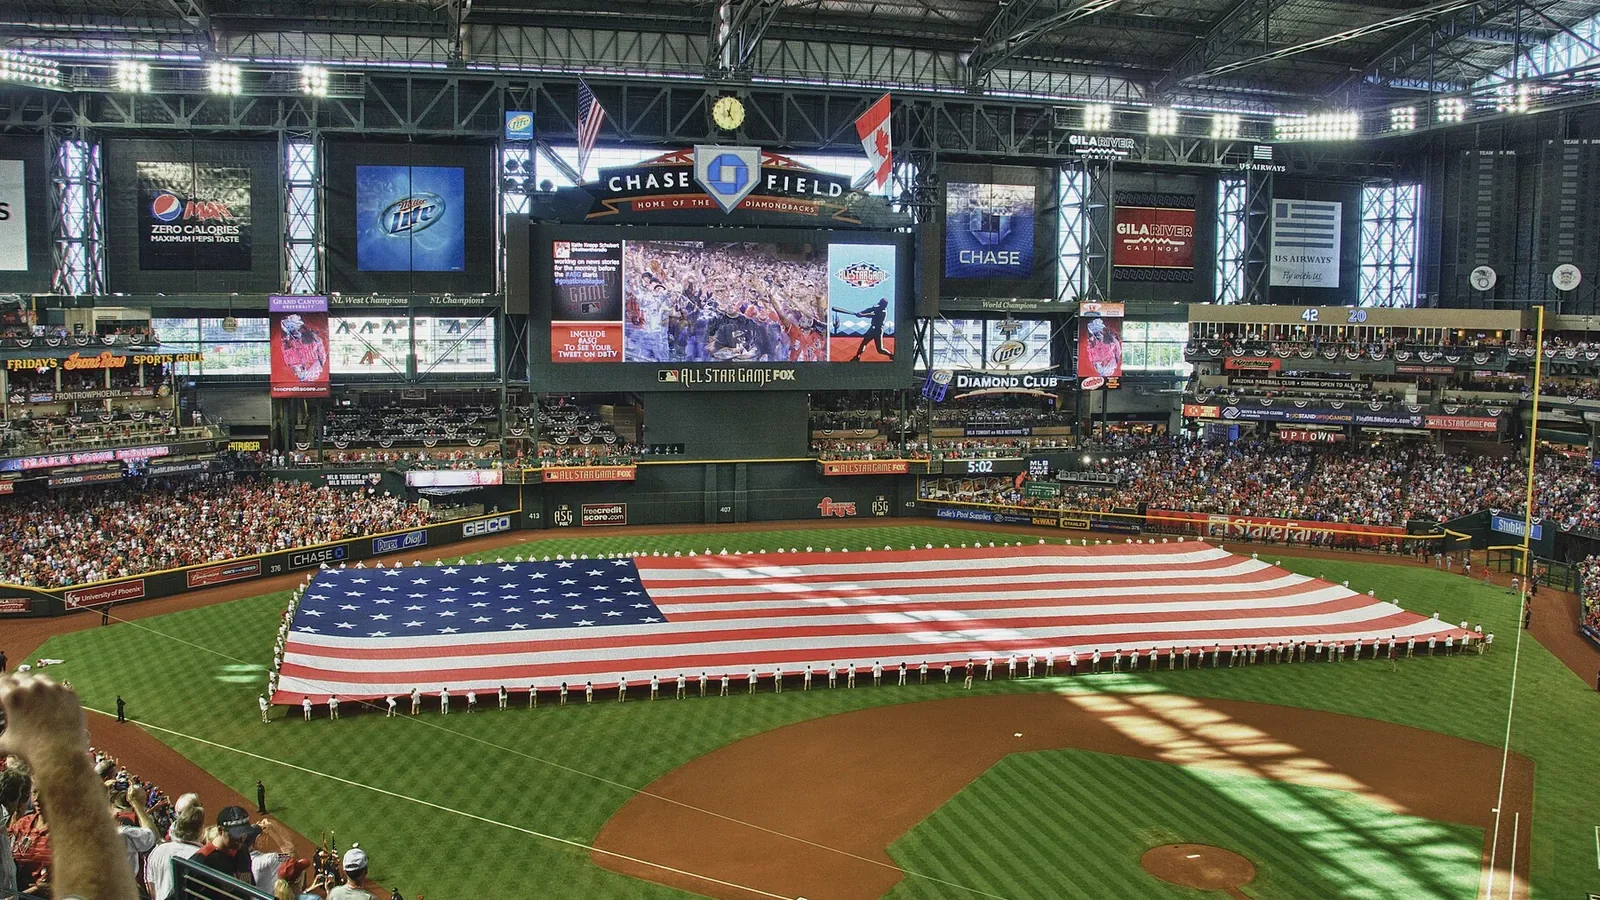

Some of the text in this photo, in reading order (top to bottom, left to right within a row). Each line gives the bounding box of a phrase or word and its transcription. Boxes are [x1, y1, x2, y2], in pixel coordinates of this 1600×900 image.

[1069, 135, 1135, 149] GILA RIVER
[1252, 164, 1286, 172] AIRWAYS
[608, 172, 842, 198] CHASE FIELD
[745, 201, 815, 213] DIAMONDBACKS
[389, 204, 435, 234] Lite
[151, 225, 239, 234] ZERO CALORIES
[1116, 223, 1193, 237] GILA RIVER
[960, 251, 1020, 265] CHASE
[1283, 271, 1311, 283] Fly with
[569, 285, 610, 302] GAME
[366, 297, 408, 305] Champions
[443, 297, 485, 305] Champions
[1003, 302, 1037, 310] Champions
[1302, 308, 1367, 322] 42 20
[998, 346, 1022, 361] Lite
[7, 358, 57, 370] FRIDAY'S
[101, 351, 127, 369] Row
[133, 354, 173, 365] SPORTS
[176, 352, 204, 363] GRILL
[681, 368, 795, 387] ALL STAR GAME FOX
[957, 375, 1058, 388] DIAMOND CLUB
[54, 389, 131, 400] FRONTROWPHOENIX.com
[1447, 418, 1465, 426] STAR
[1465, 419, 1483, 428] GAME
[1281, 430, 1335, 441] UPTOWN
[840, 464, 853, 473] ALL
[854, 464, 872, 472] STAR
[873, 464, 891, 472] GAME
[967, 461, 993, 473] 5:02
[560, 470, 574, 479] ALL
[575, 470, 594, 479] STAR
[595, 469, 616, 479] GAME
[0, 483, 13, 491] FOX
[583, 506, 622, 514] freecredit
[872, 501, 888, 515] ASG
[554, 510, 572, 524] ASG
[937, 509, 991, 522] Leslie's Pool Supplies
[464, 517, 509, 535] GEICO
[1498, 519, 1534, 537] StubHu!
[378, 531, 422, 551] Purex Dial
[293, 551, 333, 566] CHASE
[270, 564, 281, 573] 376
[81, 591, 111, 602] University
[118, 585, 141, 595] Phoenix
